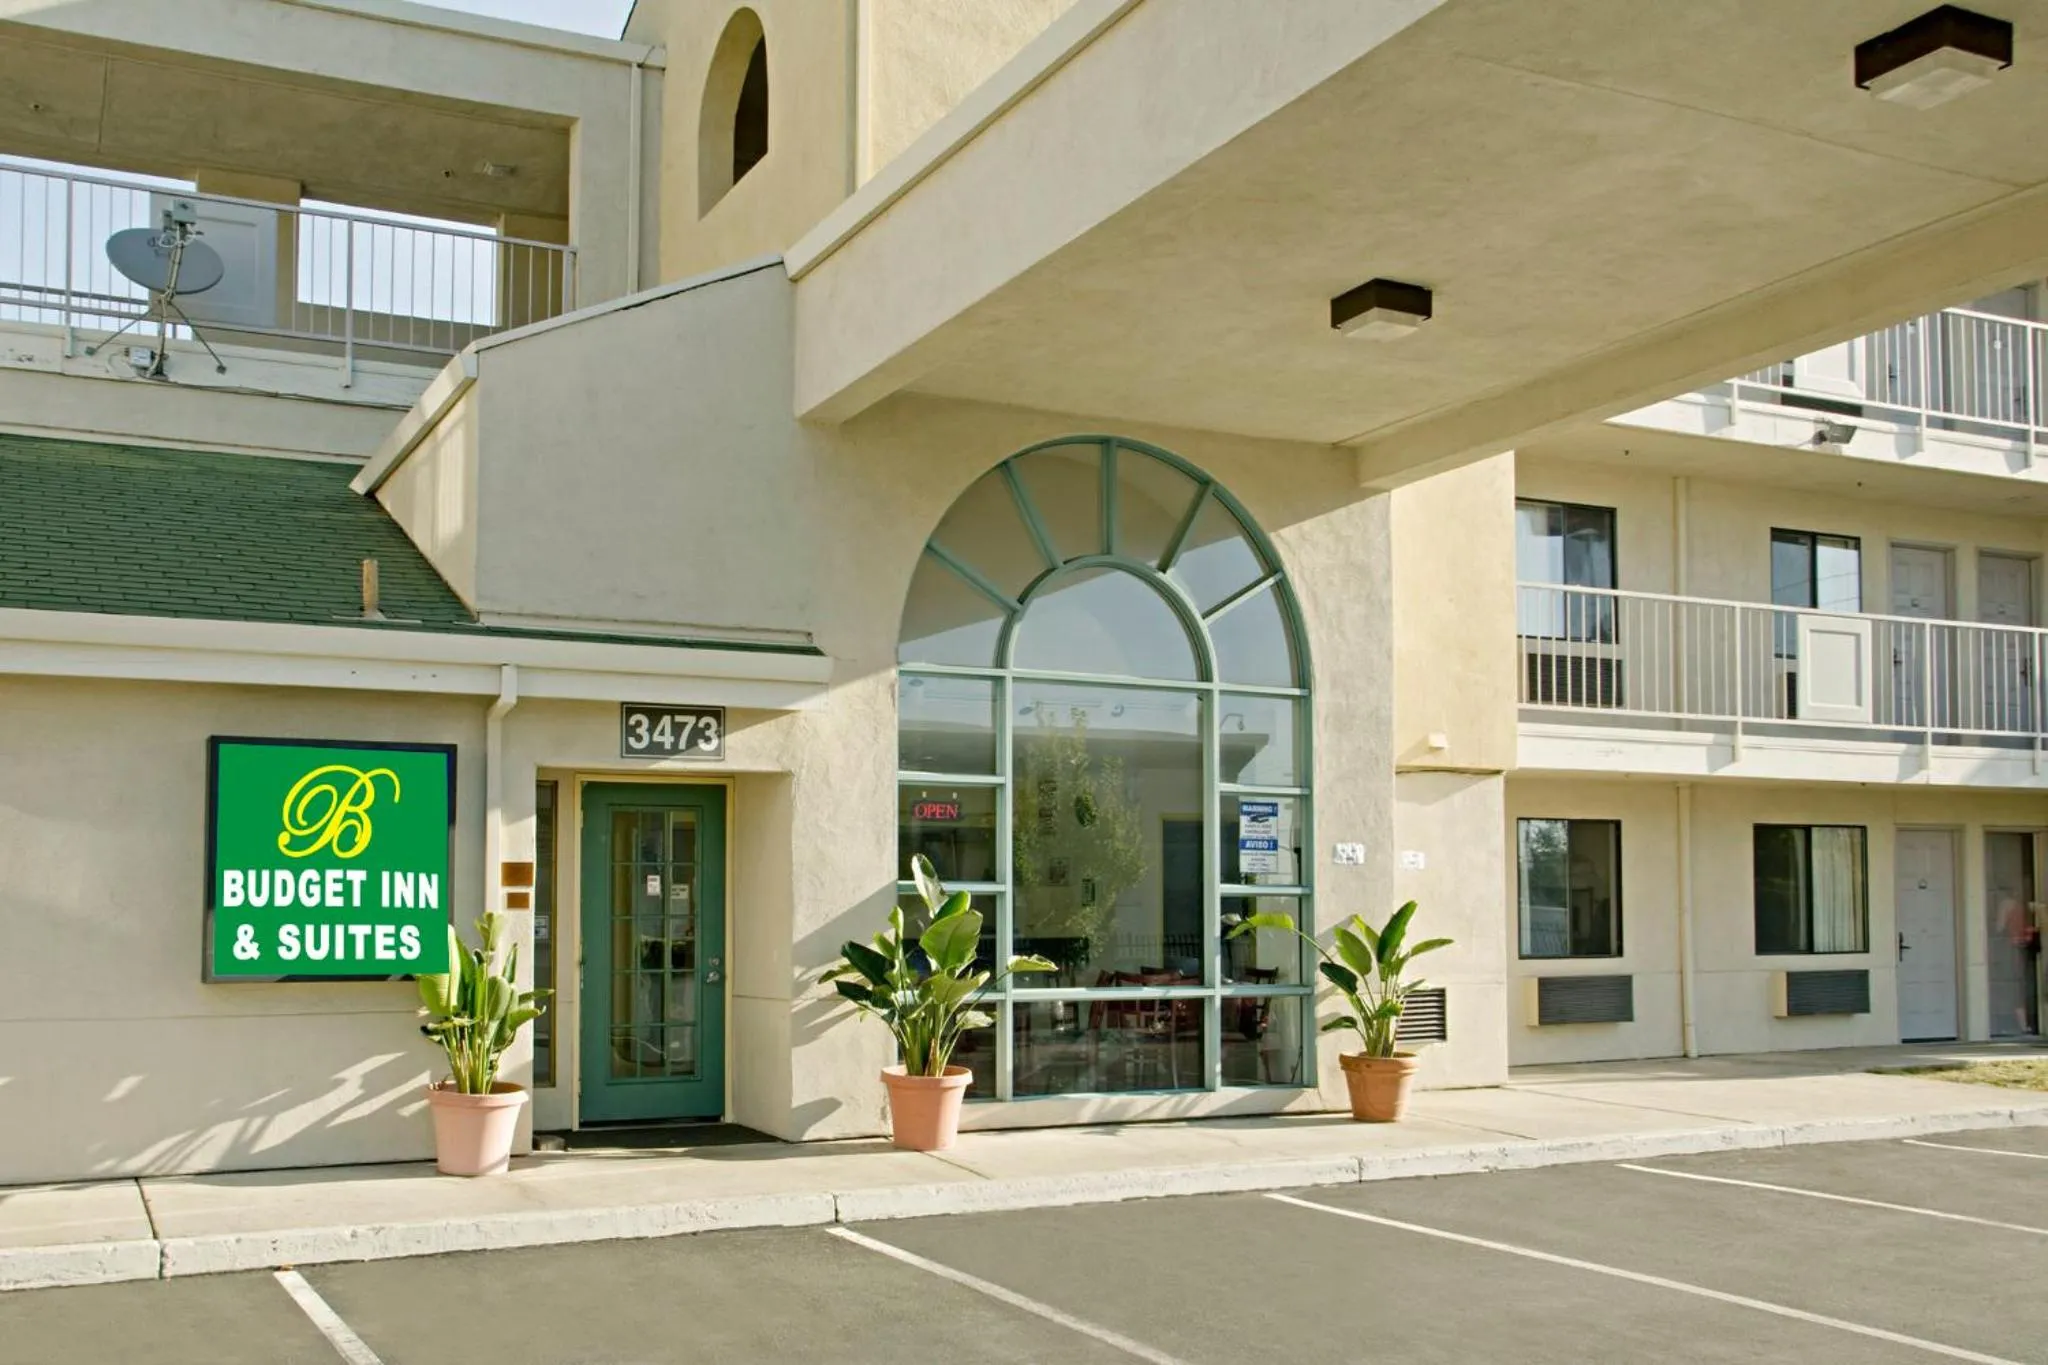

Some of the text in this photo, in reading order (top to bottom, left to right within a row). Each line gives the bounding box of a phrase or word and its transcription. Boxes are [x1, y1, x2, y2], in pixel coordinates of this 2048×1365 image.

[628, 714, 719, 751] 3473
[278, 765, 400, 858] B
[914, 803, 958, 819] OPEN
[223, 869, 439, 909] BUDGET INN
[233, 923, 421, 960] & SUITES
